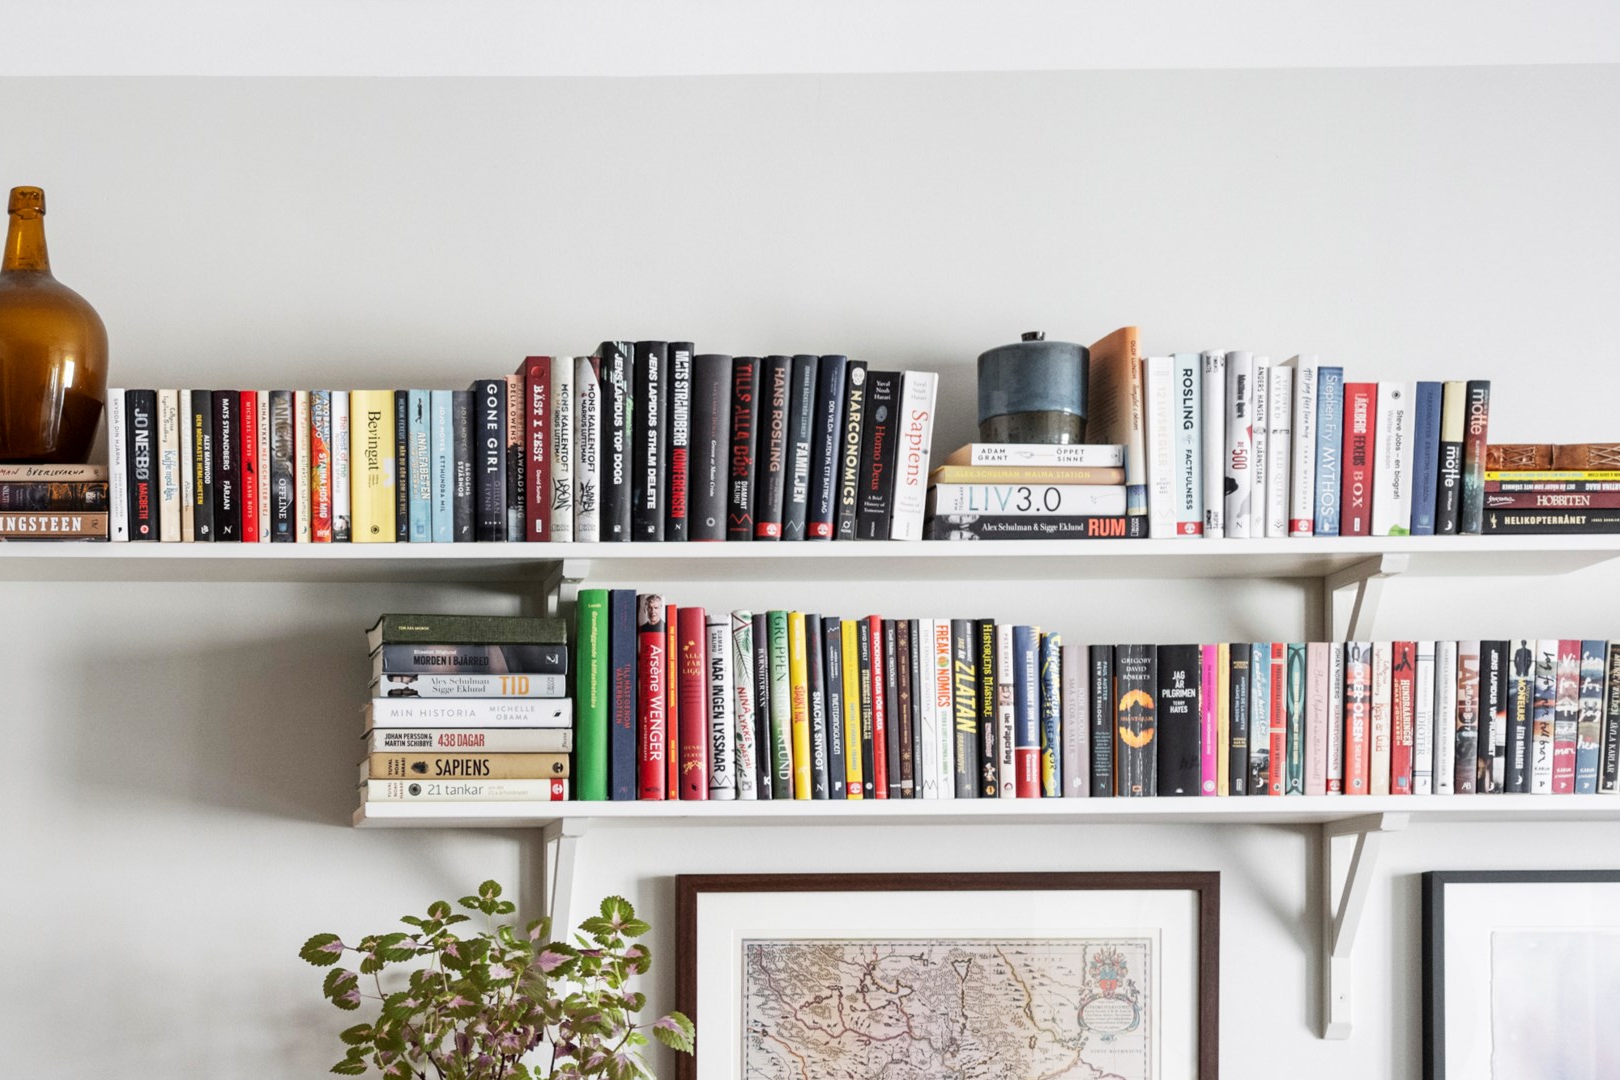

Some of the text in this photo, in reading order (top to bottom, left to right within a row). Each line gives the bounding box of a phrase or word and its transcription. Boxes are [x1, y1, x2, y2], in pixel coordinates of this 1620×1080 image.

[533, 385, 545, 415] BÄST
[773, 368, 785, 406] HANS
[1183, 368, 1193, 430] ROSLING
[1471, 388, 1486, 435] motte
[222, 420, 230, 470] STRANDBERG
[365, 411, 381, 471] Bevingat
[487, 383, 497, 474] GONE GIRL
[561, 414, 569, 473] KALLENTOFT
[614, 353, 623, 485] JENS LAPIDUS TOP DOGG
[648, 353, 657, 509] JENS LAPIDUS STHLM DELETE
[672, 351, 689, 518] MATS STRANDBERG KONFERENSEN
[733, 364, 753, 476] TILLS ALLA DÖR
[770, 410, 783, 472] ROSLING
[1321, 374, 1337, 516] Stephen Fry MYTHOS
[135, 408, 149, 519] JO NESBØ MACBETH
[417, 432, 430, 499] ANALFABETEN
[533, 432, 543, 462] TEST
[793, 442, 808, 503] FAMILJEN
[843, 390, 862, 505] NARCONOMICS
[871, 426, 885, 490] Homo Deus
[904, 410, 929, 486] Sapiens
[1256, 441, 1264, 485] HJÄRNSTARK
[1352, 393, 1368, 508] LÄCKBERG FEXEUS BOX
[1393, 410, 1403, 499] Steve Jobs en biografi
[1442, 446, 1460, 487] motte
[223, 480, 231, 510] FÄRJAN
[278, 478, 286, 519] OFFLINE
[319, 452, 327, 518] STANNA HOS MIG
[740, 480, 748, 509] DIAMANT
[1537, 496, 1590, 506] HOBBITEN
[1040, 524, 1058, 533] Sigge
[1059, 523, 1083, 531] Eklund
[1088, 518, 1125, 536] RUM
[1505, 514, 1586, 524] HELIKOPTERRÅNET
[413, 654, 489, 666] MORDEN I BJÄRRED
[774, 616, 787, 682] GRUPPEN
[449, 677, 489, 685] Schulman
[457, 685, 486, 693] Eklund
[499, 676, 529, 695] TID
[650, 645, 662, 761] Arsène WENGER
[875, 696, 883, 710] FÖR
[955, 661, 976, 734] ZLATAN
[1353, 661, 1363, 742] ADLER-OLSEN
[1490, 650, 1498, 704] JENS LAPIDUS
[391, 709, 476, 717] MIN HISTORIA
[712, 658, 726, 772] NÄR INGEN LYSSNAR
[813, 691, 822, 731] SNACKA
[1400, 679, 1413, 746] HUNDRAÅRINGEN
[438, 734, 455, 747] 438
[457, 734, 485, 747] DAGAR
[778, 728, 791, 780] EKLUND
[814, 733, 823, 771] SNYGGT
[1003, 725, 1013, 764] Paperboy
[428, 784, 484, 795] 21 tankar
[435, 759, 490, 776] SAPIENS
